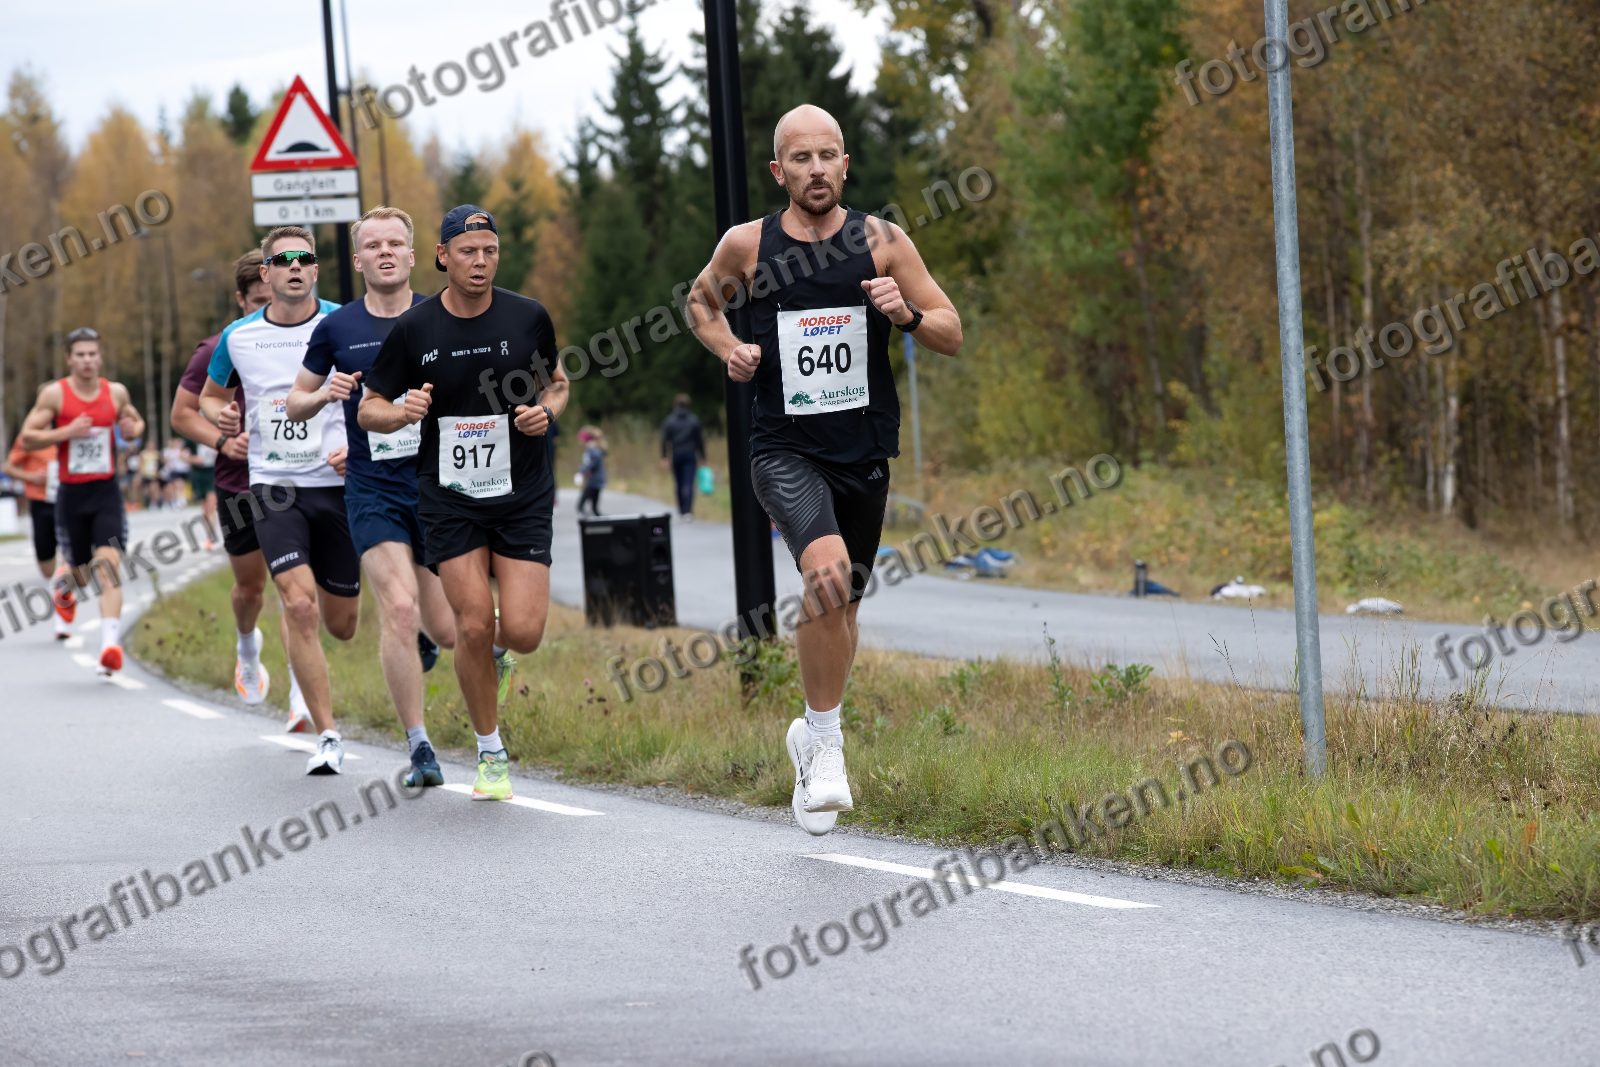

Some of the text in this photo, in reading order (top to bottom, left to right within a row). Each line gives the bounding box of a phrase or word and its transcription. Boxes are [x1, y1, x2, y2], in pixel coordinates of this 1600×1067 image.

[799, 314, 852, 327] NORGES
[803, 325, 843, 337] LØPET
[255, 340, 303, 351] Norconsult
[797, 342, 852, 377] 640
[819, 385, 866, 399] Aurskog
[271, 418, 308, 441] 783
[454, 421, 496, 431] NORGES
[458, 430, 490, 439] LØPET
[285, 450, 320, 459] Aurskog
[452, 443, 496, 470] 917
[469, 477, 509, 489] Aurskog
